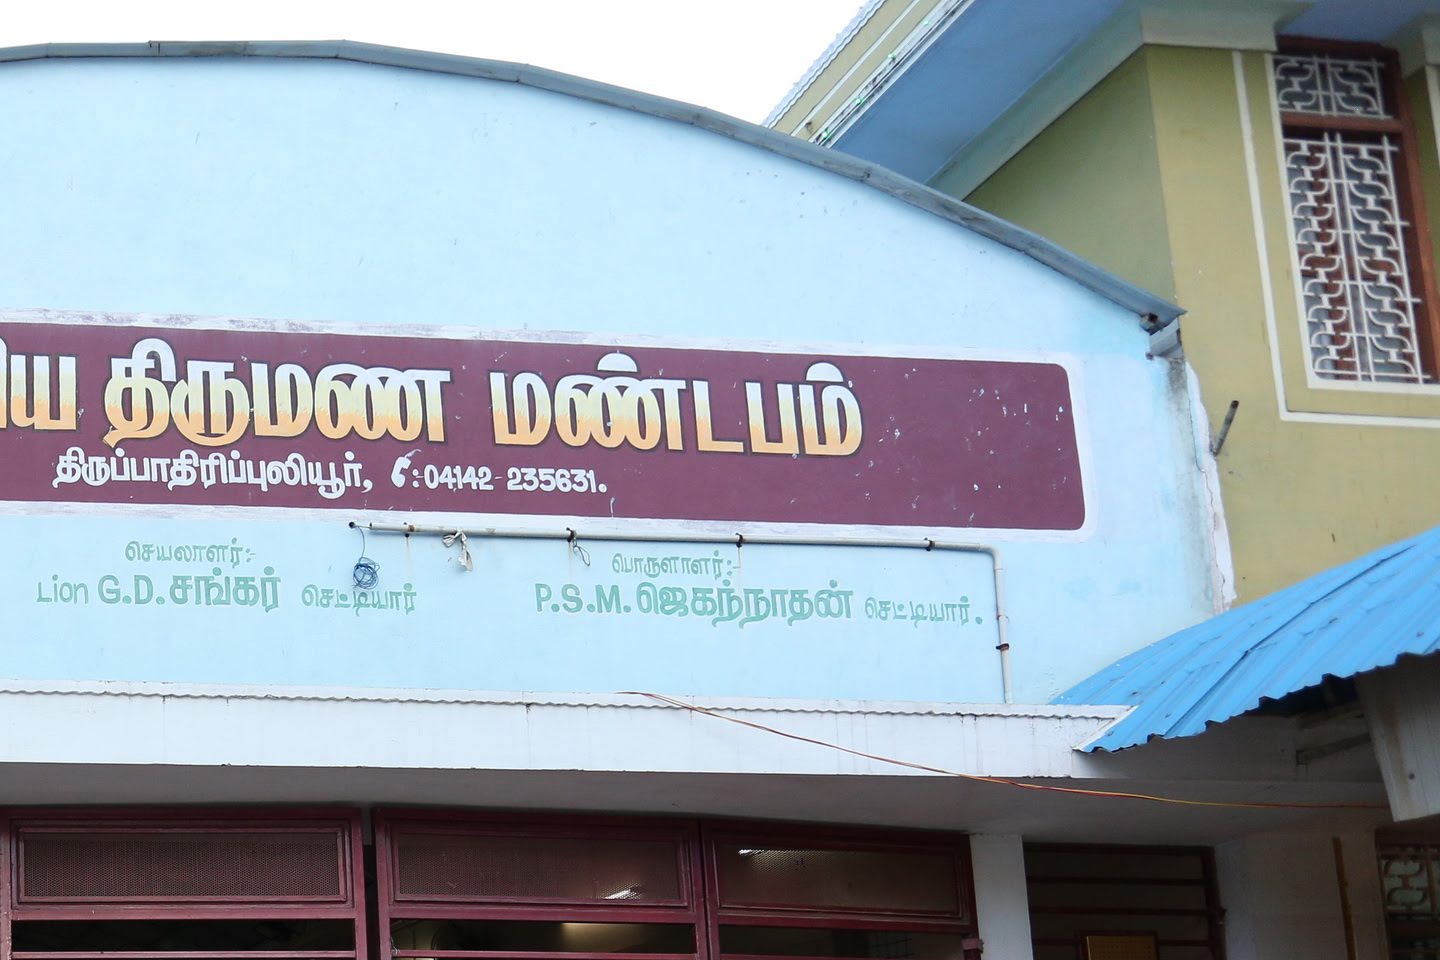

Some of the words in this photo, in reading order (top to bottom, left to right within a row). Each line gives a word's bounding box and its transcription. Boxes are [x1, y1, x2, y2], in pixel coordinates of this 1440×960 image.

[103, 337, 451, 447] திருமண
[490, 351, 863, 456] மண்டபம்
[36, 574, 89, 604] Lion
[301, 582, 417, 617] செட்டியார்
